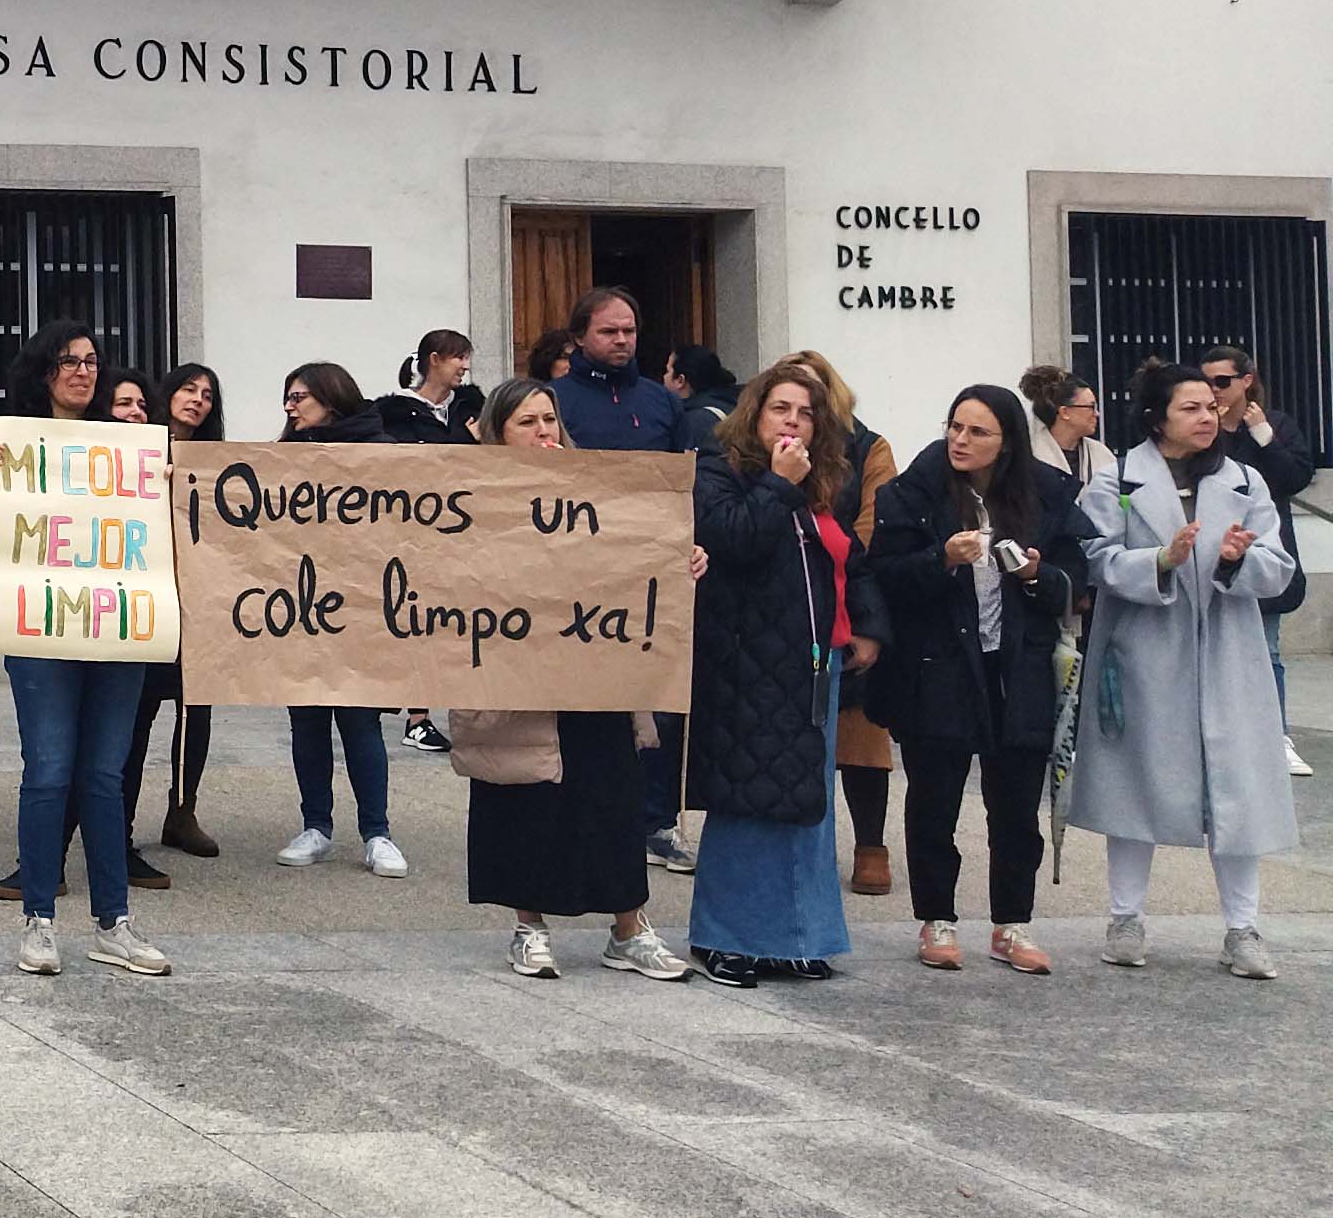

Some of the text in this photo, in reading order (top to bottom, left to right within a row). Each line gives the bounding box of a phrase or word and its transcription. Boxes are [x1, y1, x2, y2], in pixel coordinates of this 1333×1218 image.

[93, 37, 539, 96] CONSISTORIAL
[835, 204, 981, 232] CONCELLO
[836, 244, 874, 270] DE
[837, 285, 957, 311] CAMBRE
[61, 445, 162, 499] COLE
[187, 462, 599, 544] ¡Queremos un
[11, 513, 148, 571] MEJOR
[232, 554, 658, 668] cole limpo xa!
